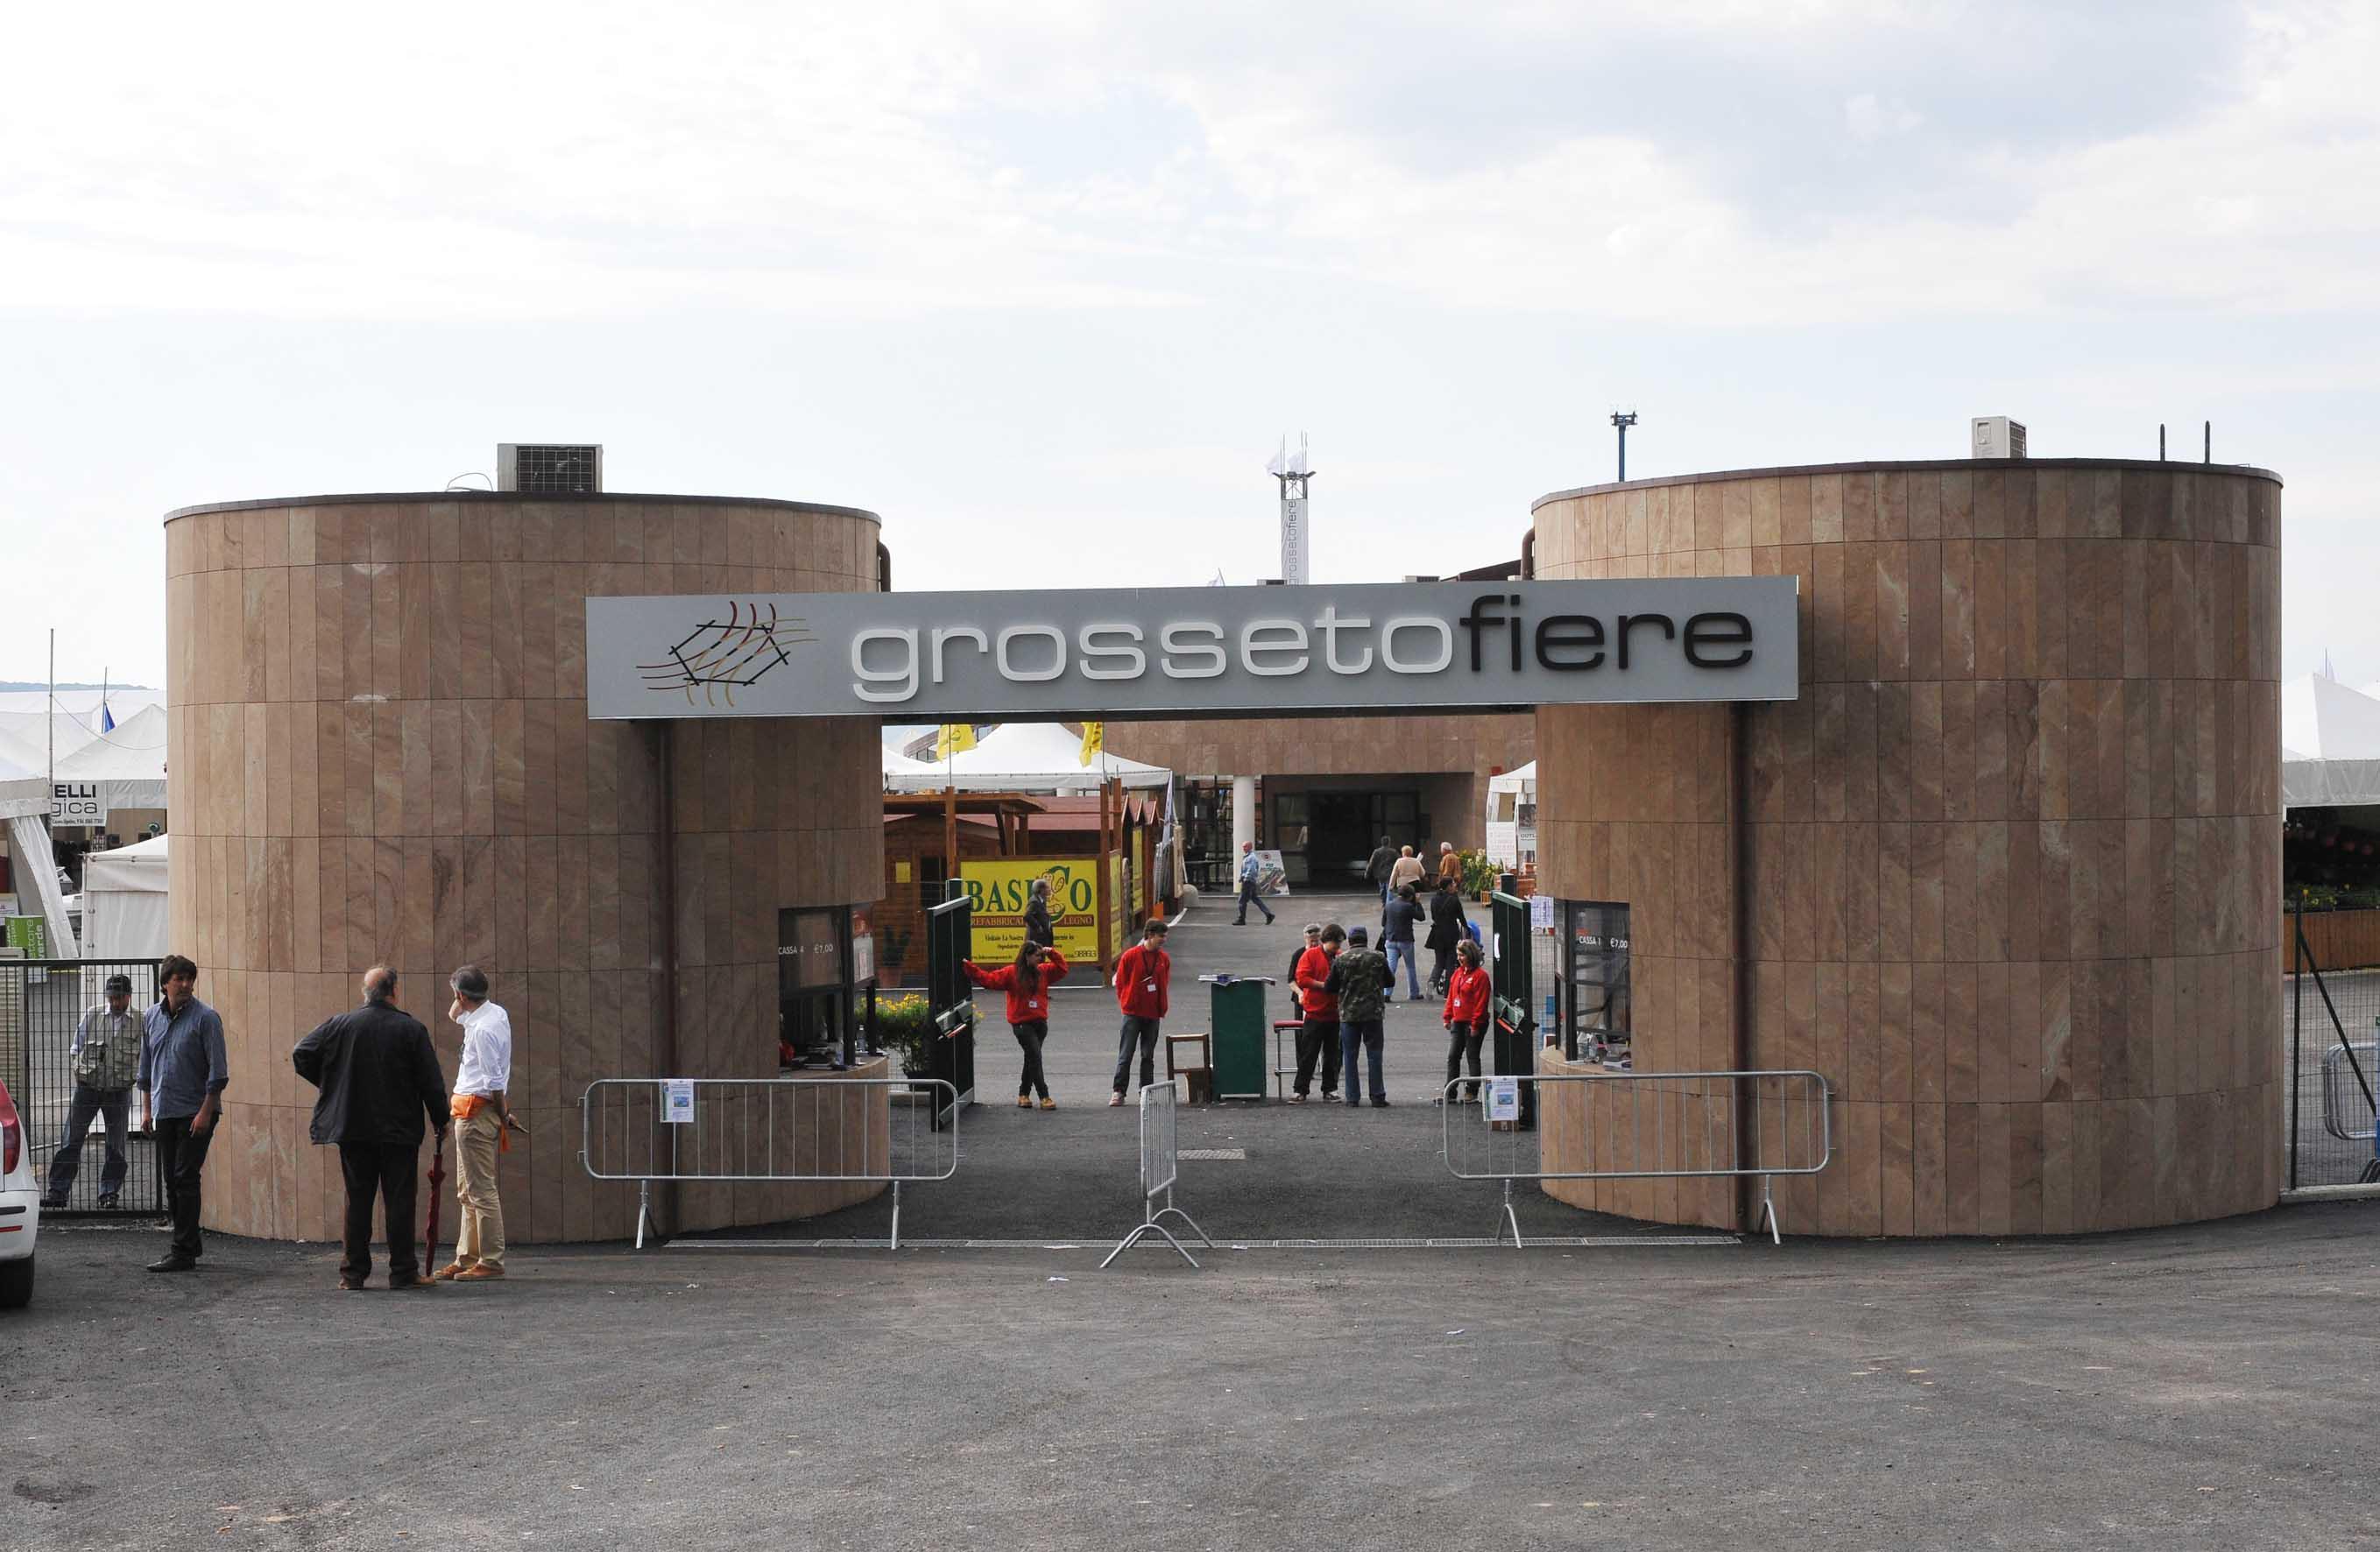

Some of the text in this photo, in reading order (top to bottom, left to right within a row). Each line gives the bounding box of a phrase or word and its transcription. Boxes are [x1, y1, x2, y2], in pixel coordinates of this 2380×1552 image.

[851, 594, 1754, 703] grossetofiere
[1578, 935, 1597, 945] CASSA
[778, 945, 798, 955] CASSA
